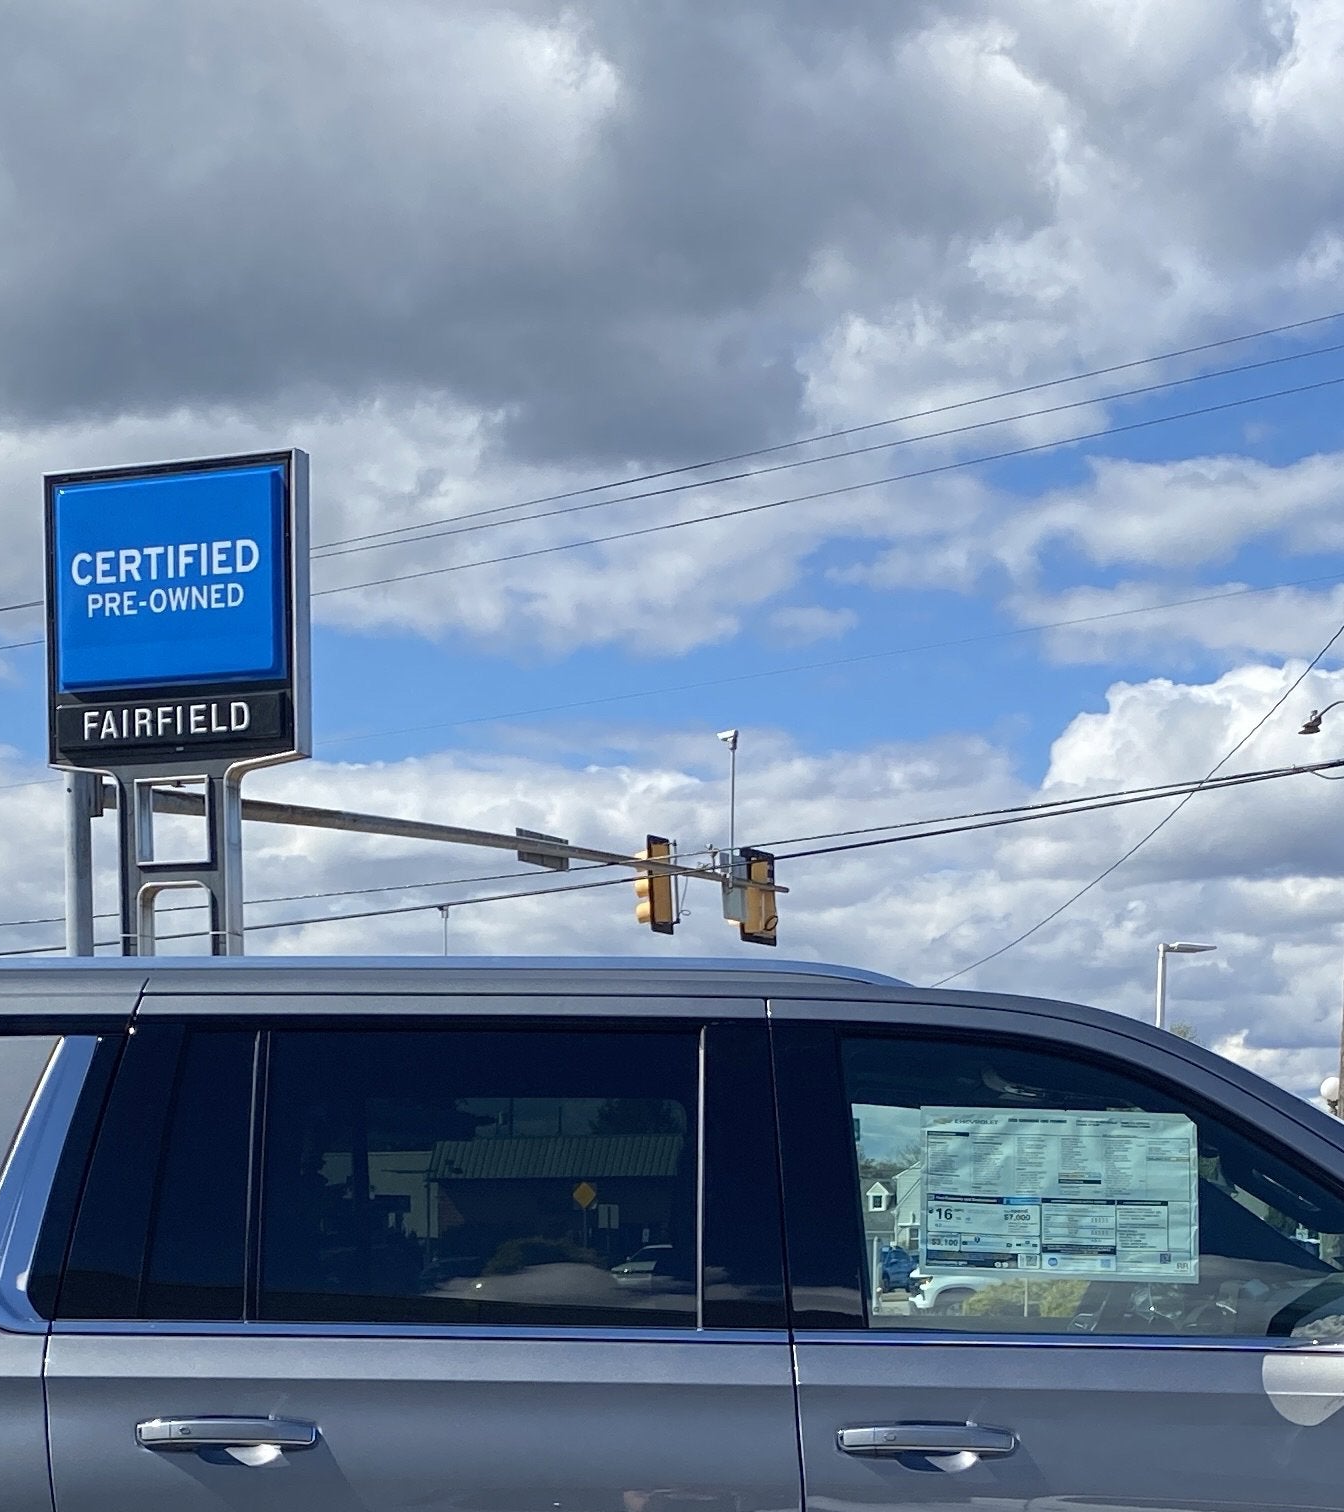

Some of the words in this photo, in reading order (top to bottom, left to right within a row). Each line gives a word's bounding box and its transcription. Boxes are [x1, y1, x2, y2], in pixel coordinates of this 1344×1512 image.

[71, 538, 260, 586] CERTIFIED
[87, 583, 244, 618] PRE-OWNED
[83, 700, 251, 742] FAIRFIELD
[936, 1208, 953, 1220] 16
